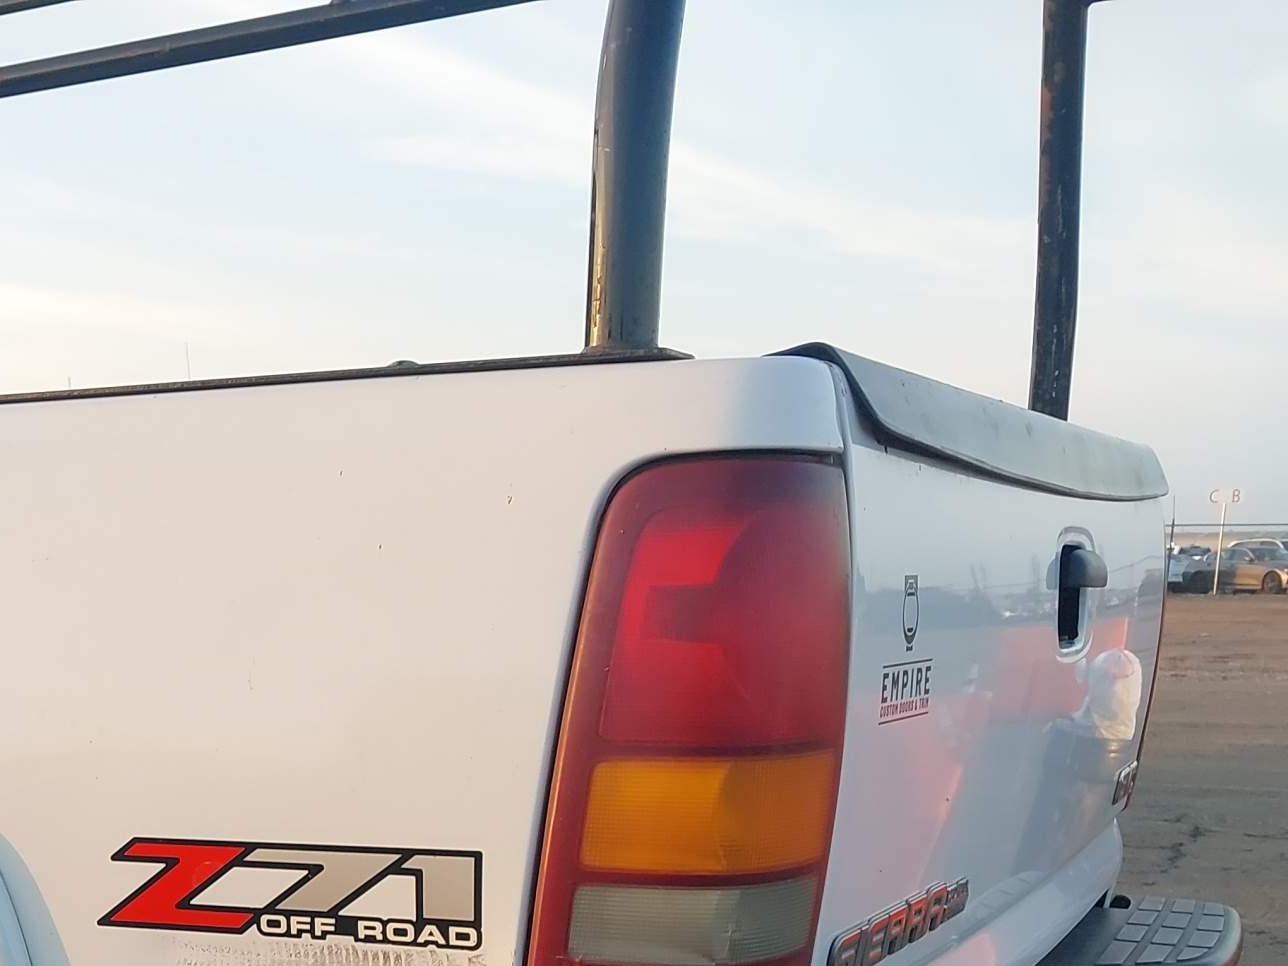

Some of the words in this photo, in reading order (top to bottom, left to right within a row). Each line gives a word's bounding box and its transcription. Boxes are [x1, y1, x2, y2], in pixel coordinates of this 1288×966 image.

[880, 665, 932, 704] EMPIRE
[879, 703, 899, 719] CUSTOM
[899, 700, 914, 714] DOORS
[97, 837, 483, 934] Z71
[257, 914, 338, 941] OFF
[356, 920, 483, 950] ROAD
